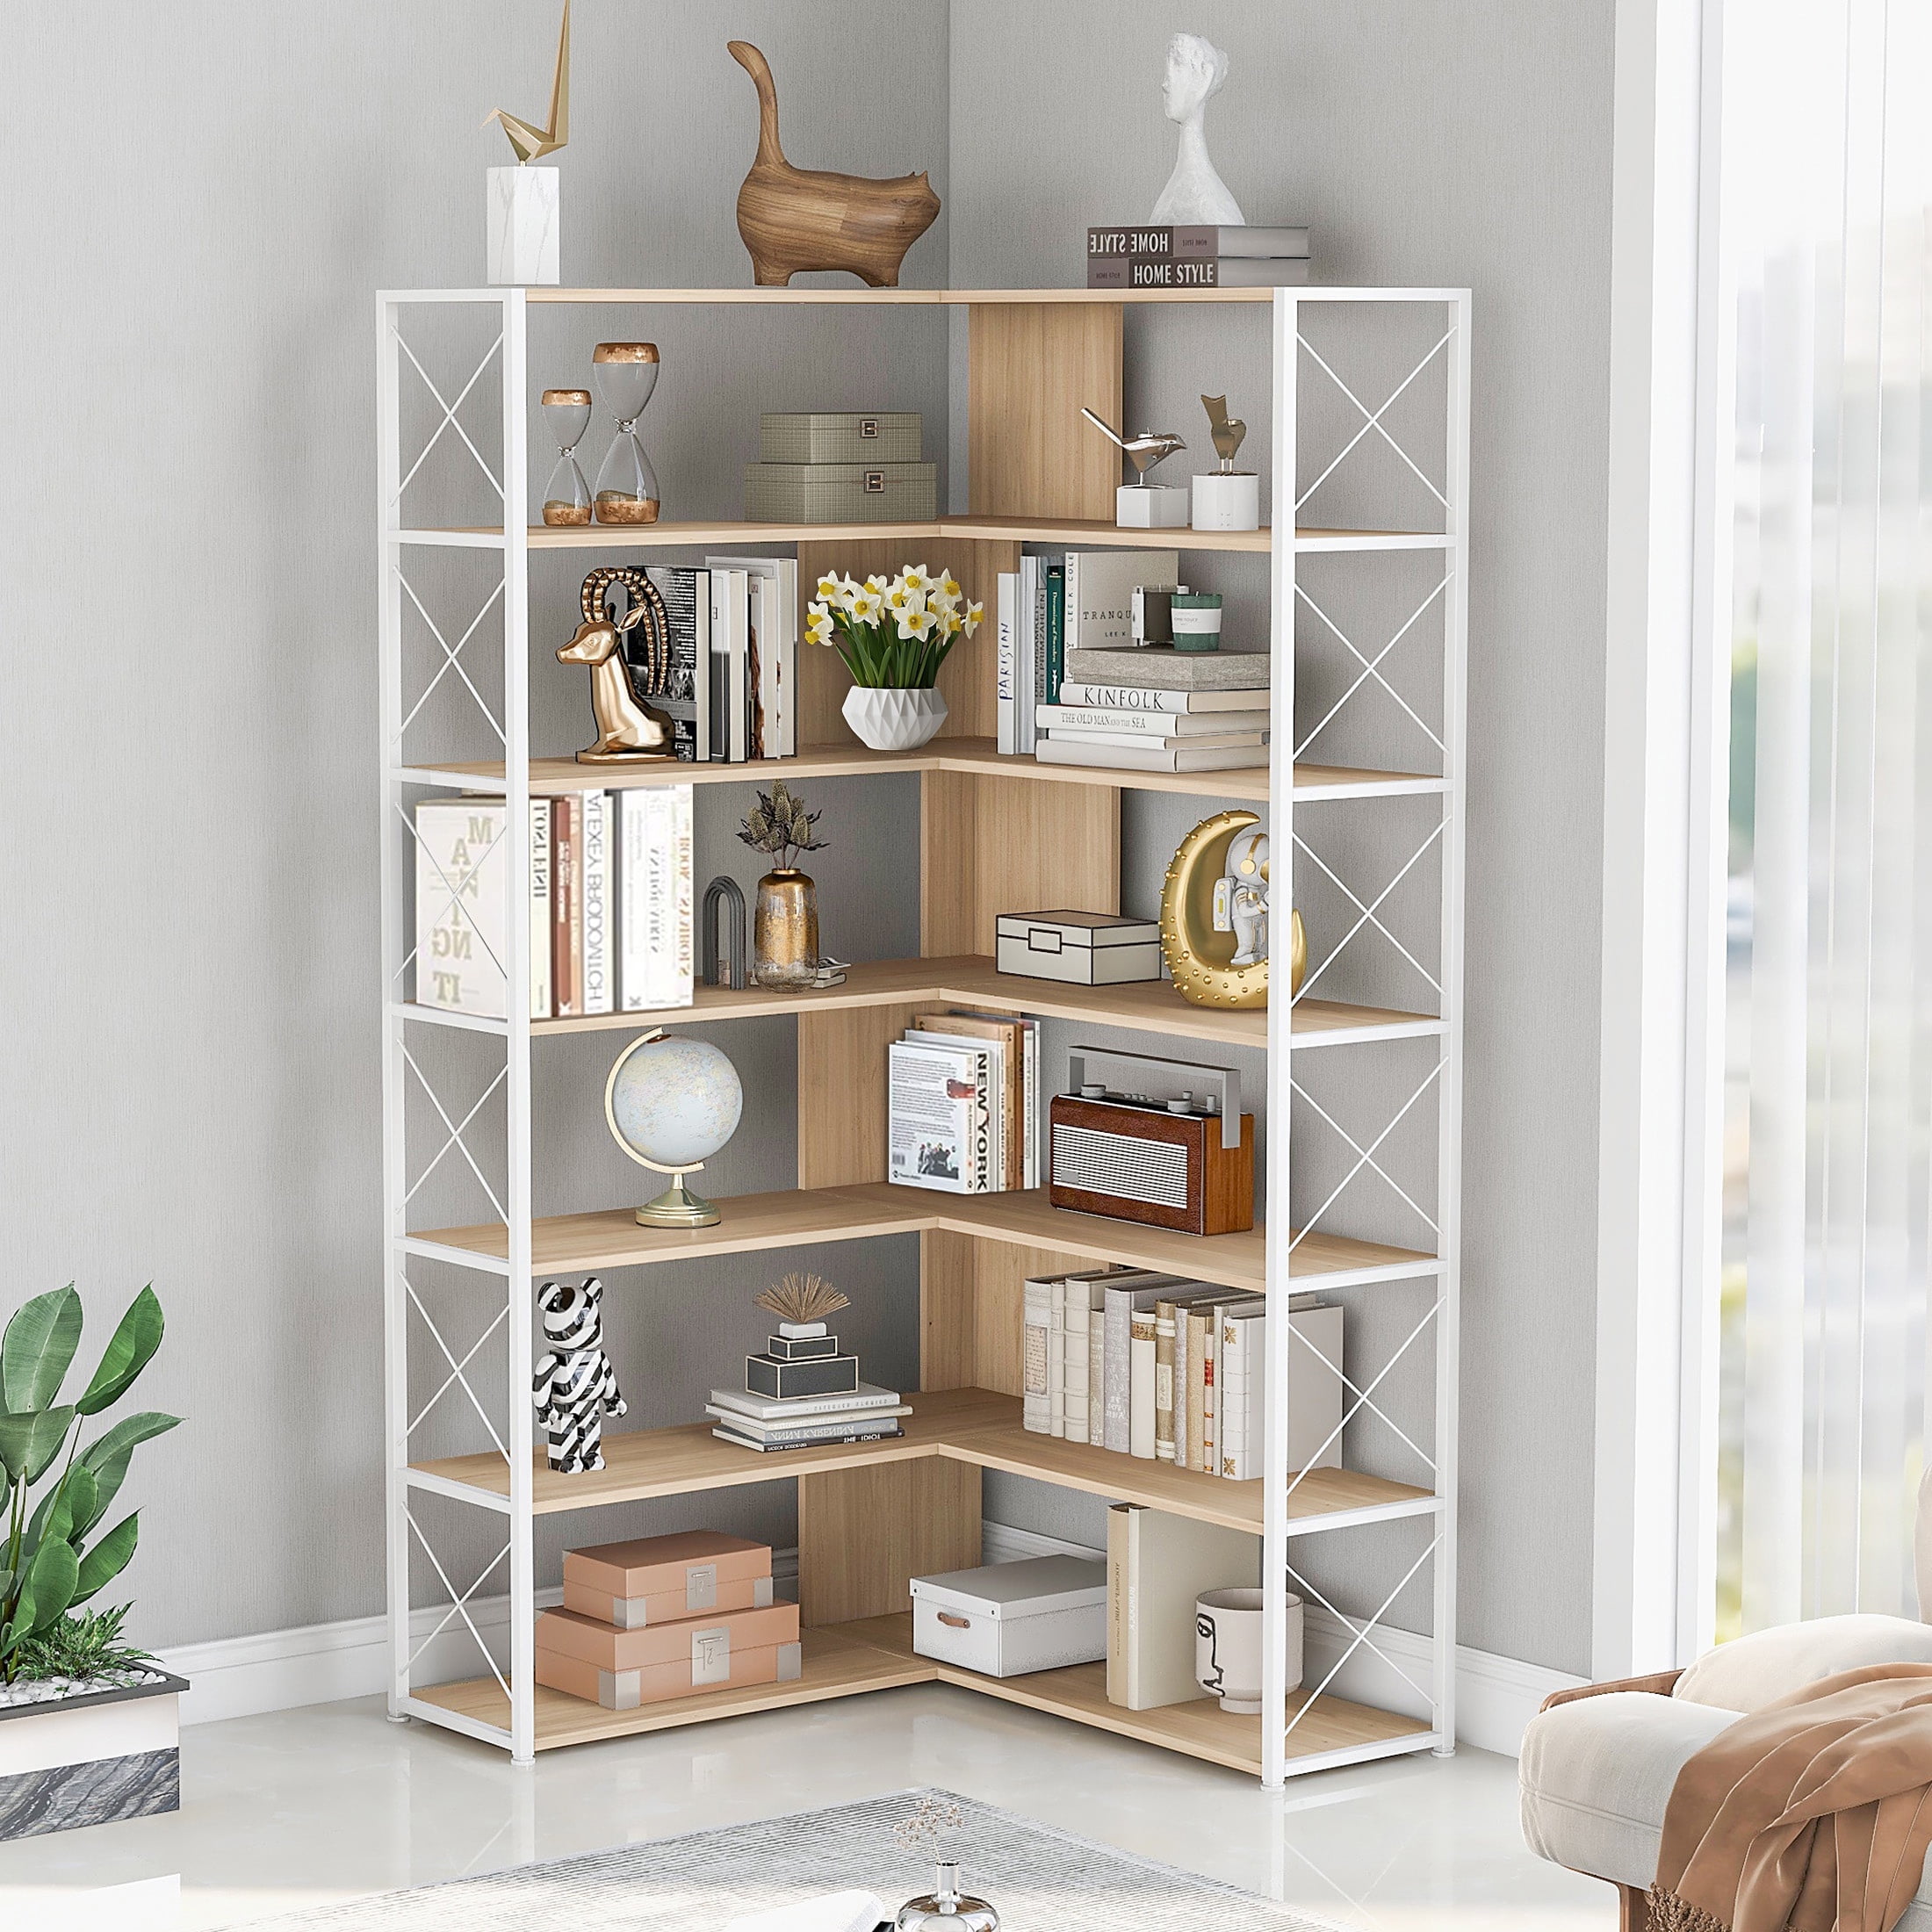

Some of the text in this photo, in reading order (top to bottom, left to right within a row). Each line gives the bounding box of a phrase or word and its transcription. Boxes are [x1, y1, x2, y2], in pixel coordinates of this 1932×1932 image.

[1134, 263, 1214, 285] HOME STYLE
[998, 623, 1014, 701] PARISIAN
[1085, 687, 1164, 710] KINFOLK
[1061, 712, 1076, 724] THE
[1077, 713, 1093, 724] OLD
[1093, 714, 1111, 725] MAN
[1132, 717, 1146, 729] SEA
[977, 1053, 990, 1191] NEW YORK
